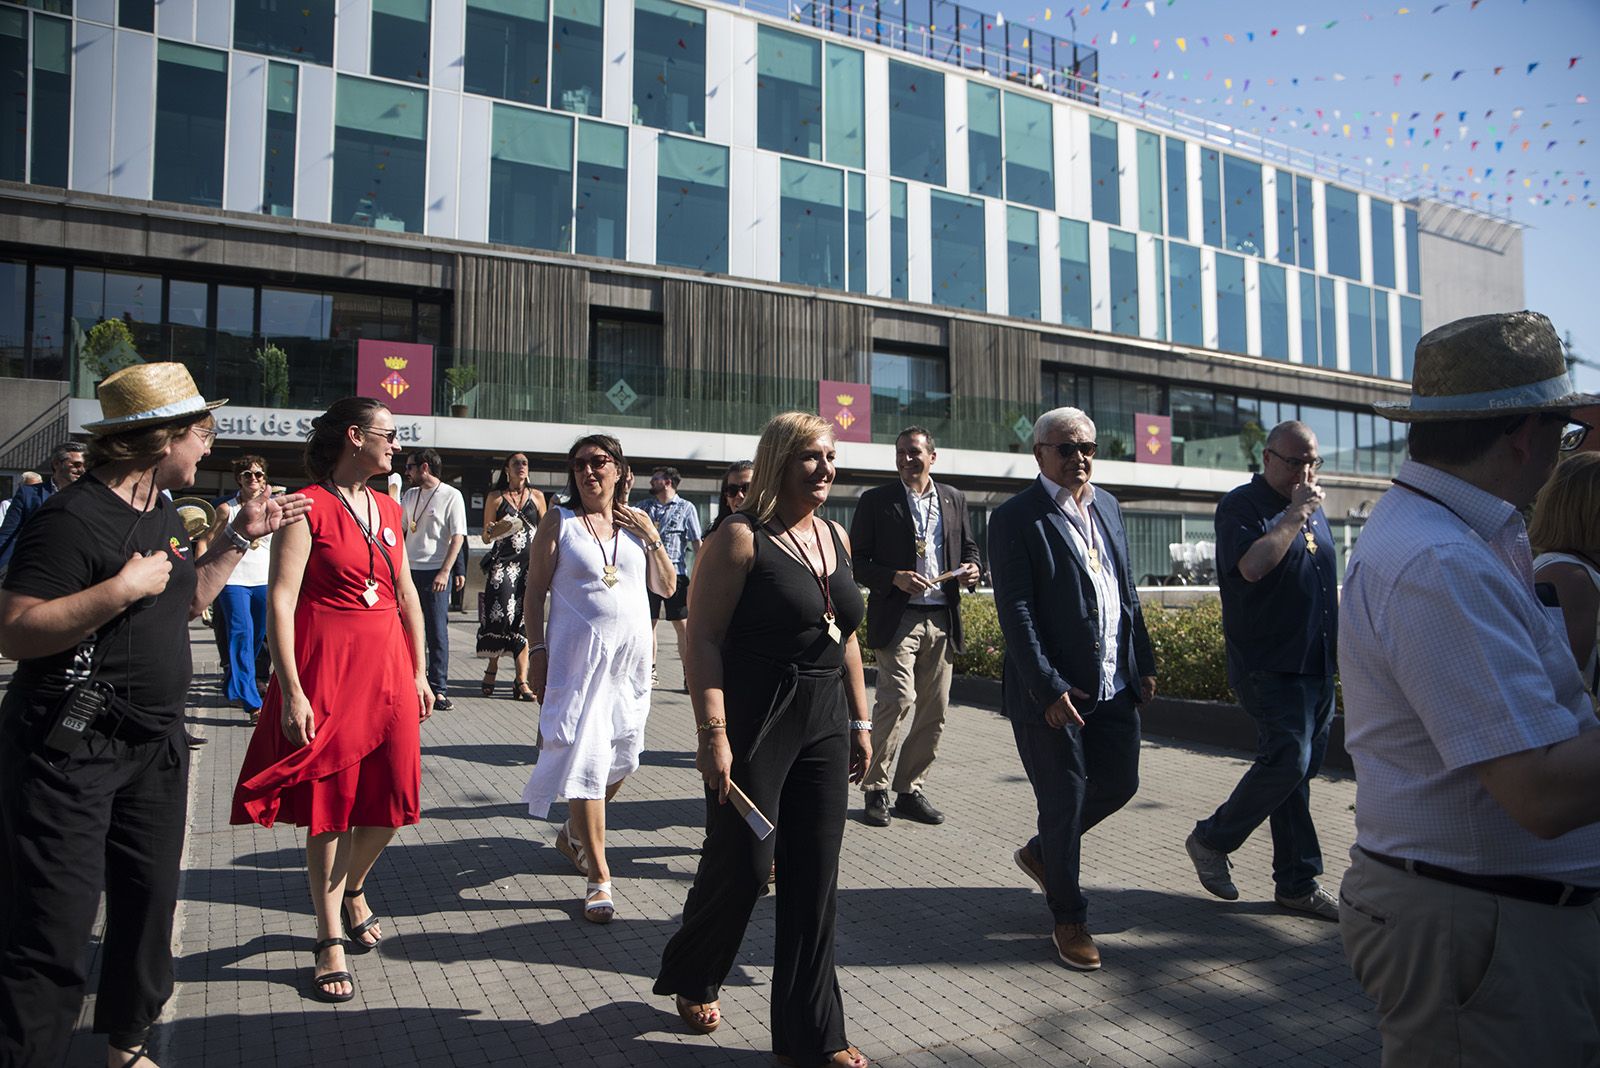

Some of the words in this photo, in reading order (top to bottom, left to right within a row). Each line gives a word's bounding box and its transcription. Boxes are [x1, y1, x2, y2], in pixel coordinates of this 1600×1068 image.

[1488, 397, 1522, 409] Festa
[215, 414, 258, 435] ent
[261, 413, 293, 436] de
[398, 422, 421, 442] at
